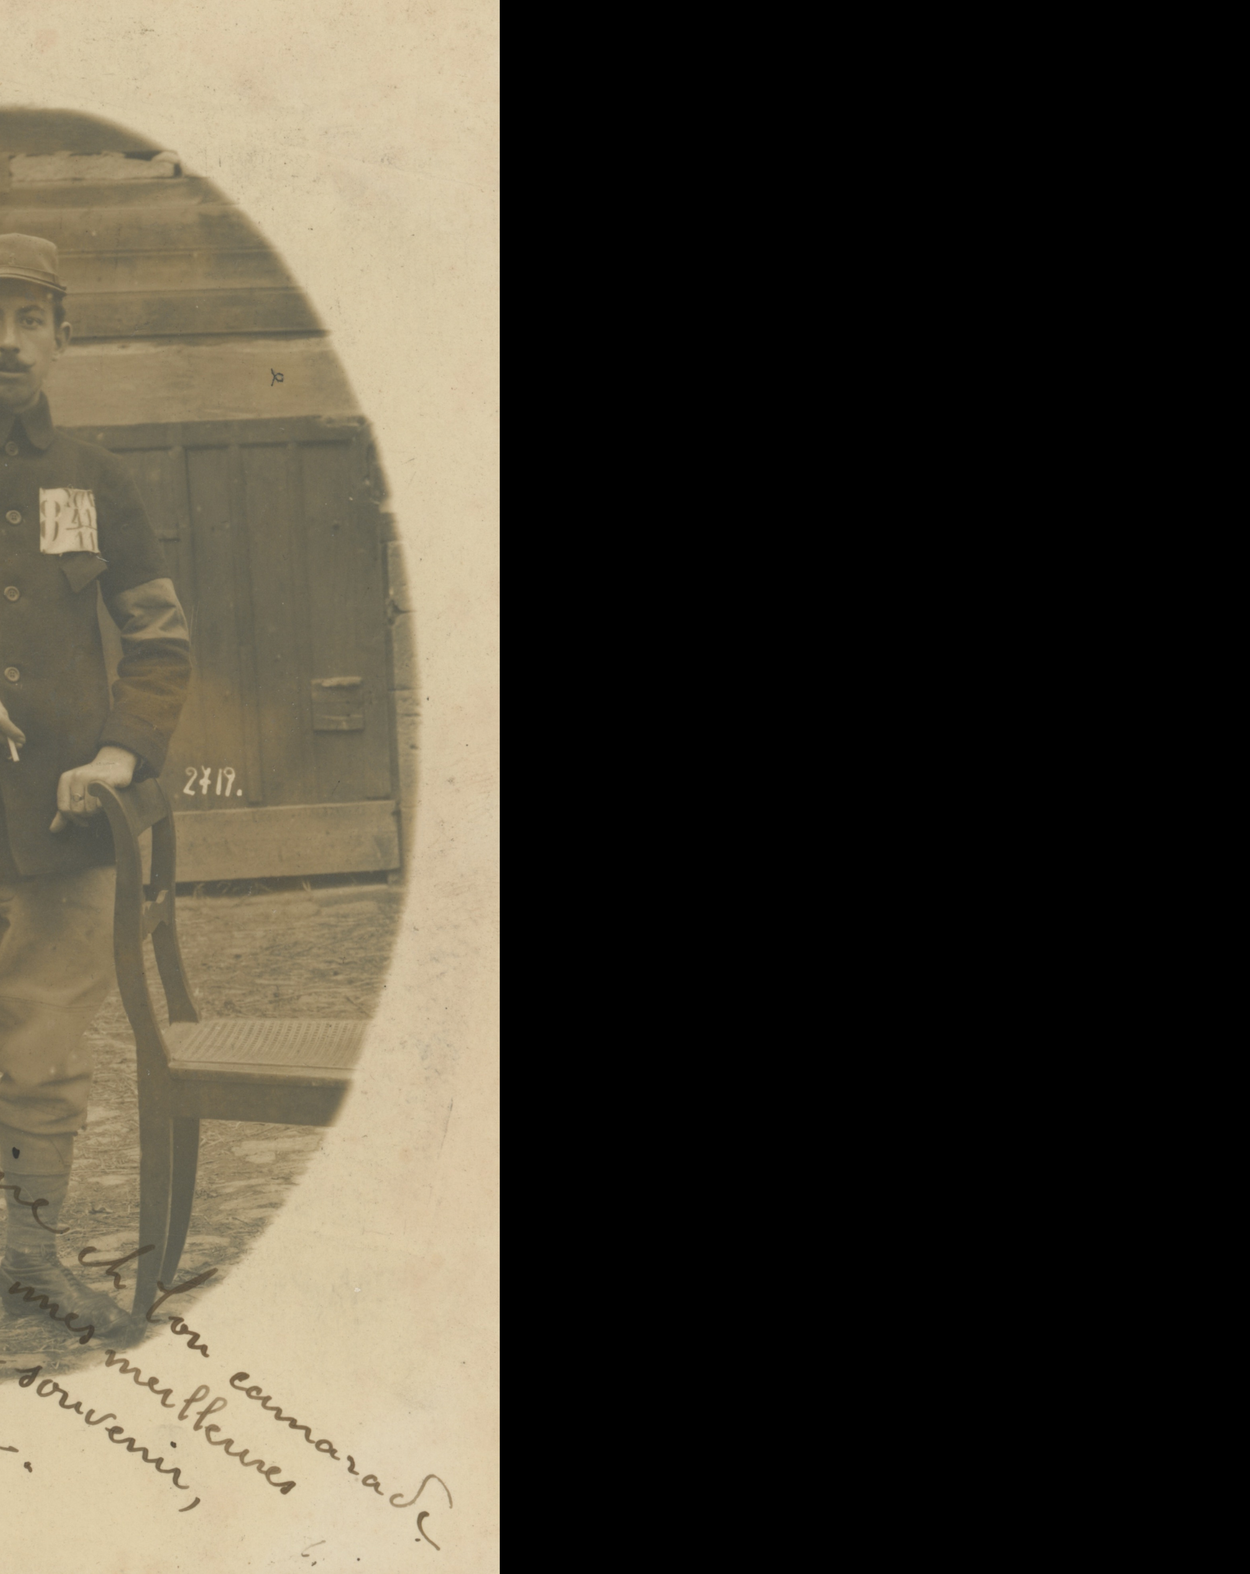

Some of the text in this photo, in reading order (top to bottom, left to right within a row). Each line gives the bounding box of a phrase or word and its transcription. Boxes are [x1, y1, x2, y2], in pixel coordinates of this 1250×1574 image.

[9, 1281, 95, 1345] mes
[78, 1244, 155, 1290] et
[146, 1267, 219, 1358] bon
